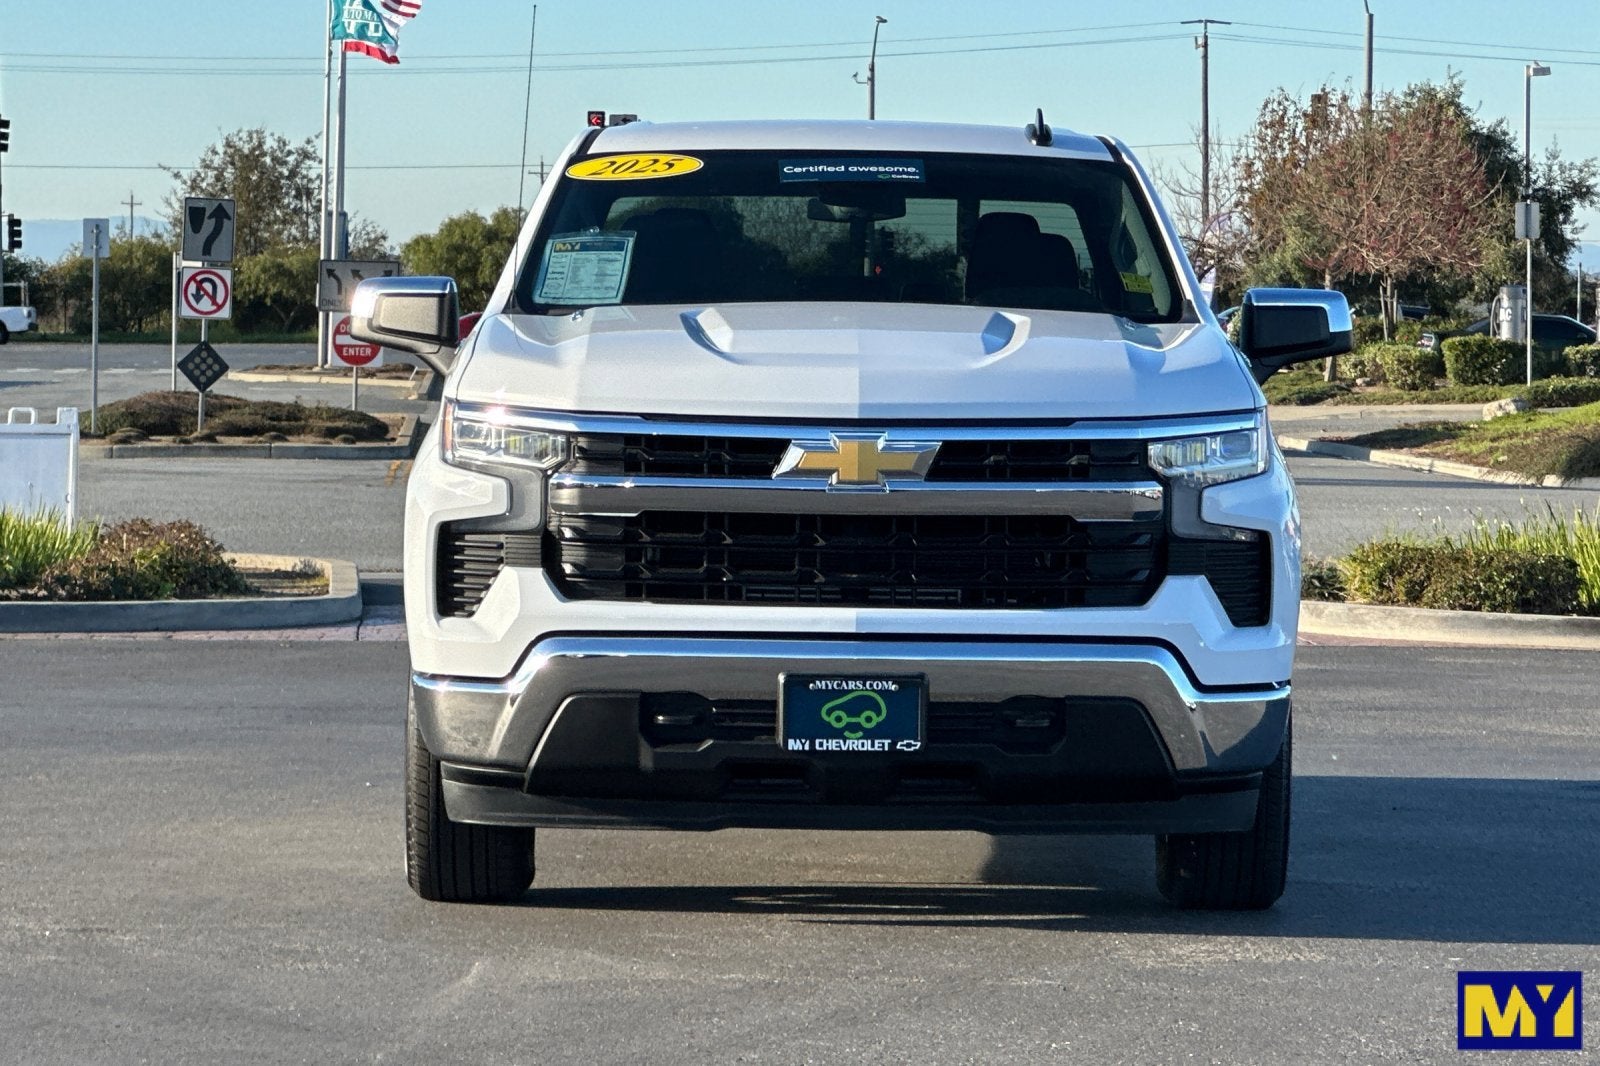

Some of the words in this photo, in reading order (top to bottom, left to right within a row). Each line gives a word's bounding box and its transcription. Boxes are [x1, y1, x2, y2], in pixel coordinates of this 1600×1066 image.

[586, 158, 684, 176] 2025
[783, 165, 845, 173] Certified
[848, 165, 919, 173] awesome.
[342, 347, 372, 356] ENTER
[815, 680, 893, 690] MYCARS.COM
[788, 738, 810, 751] MY
[815, 738, 892, 751] CHEVROLET
